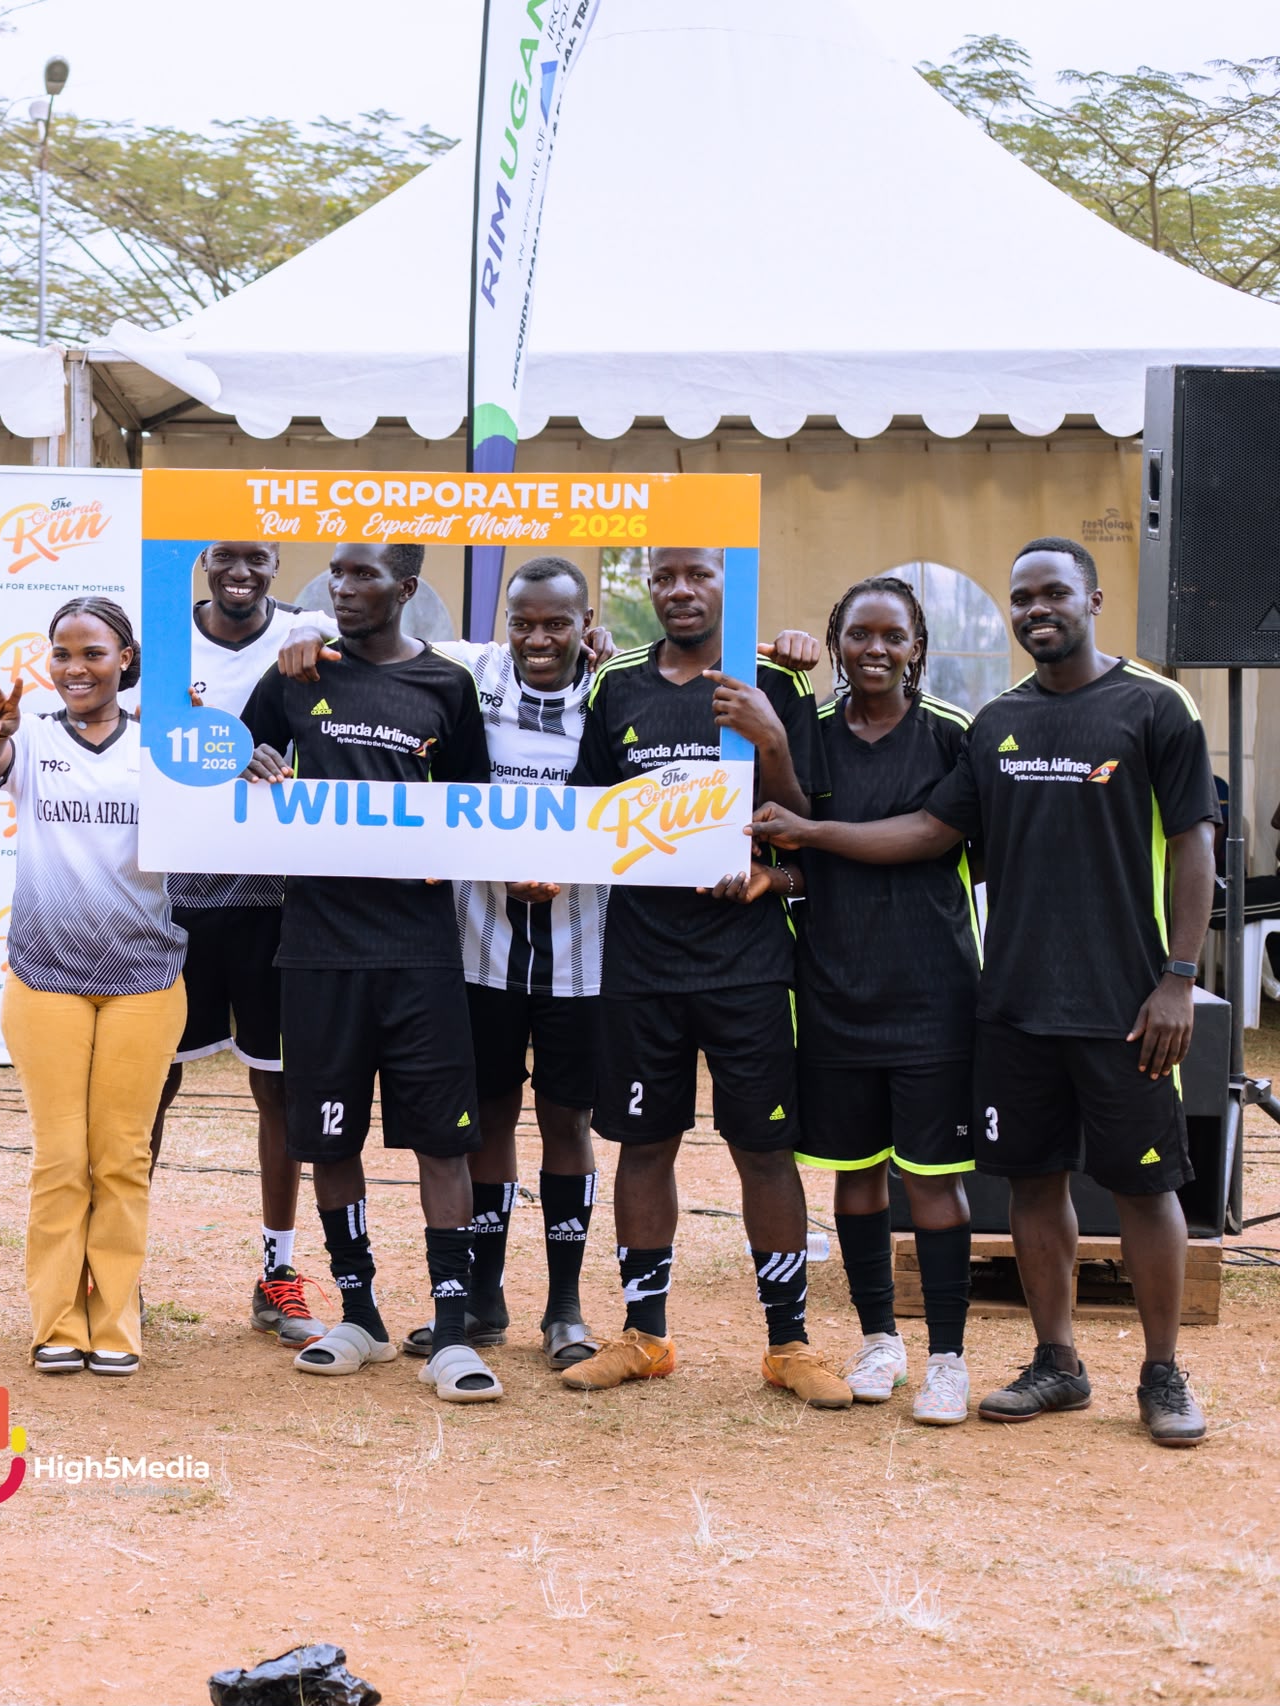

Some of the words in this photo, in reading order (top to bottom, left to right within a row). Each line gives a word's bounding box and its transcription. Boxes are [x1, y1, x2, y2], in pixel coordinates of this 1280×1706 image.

[536, 128, 546, 152] OF
[50, 497, 72, 511] The
[247, 479, 318, 505] THE
[329, 480, 559, 509] CORPORATE
[570, 483, 649, 510] RUN
[26, 500, 103, 526] Corporate
[316, 508, 347, 536] For
[362, 512, 462, 542] Expectant
[569, 514, 648, 538] 2026
[27, 583, 80, 591] EXPECTANT
[82, 584, 125, 592] MOTHERS
[166, 726, 199, 763] 11
[210, 725, 229, 737] TH
[204, 741, 235, 753] OCT
[321, 720, 372, 737] Uganda
[373, 725, 421, 749] Airlines
[201, 758, 237, 770] 2026
[628, 744, 671, 763] Uganda
[672, 743, 720, 758] Airlines
[1000, 757, 1048, 775] Uganda
[1050, 758, 1092, 775] Airlines
[627, 769, 730, 808] Corporate
[661, 768, 689, 786] The
[37, 799, 91, 823] UGANDA
[94, 801, 139, 825] AIRLI
[234, 779, 248, 824] I
[269, 780, 425, 827] WILL
[446, 784, 577, 832] RUN
[586, 777, 741, 875] Run
[628, 1081, 643, 1115] 2
[321, 1101, 344, 1135] 12
[985, 1106, 999, 1141] 3
[548, 1231, 587, 1242] adidas
